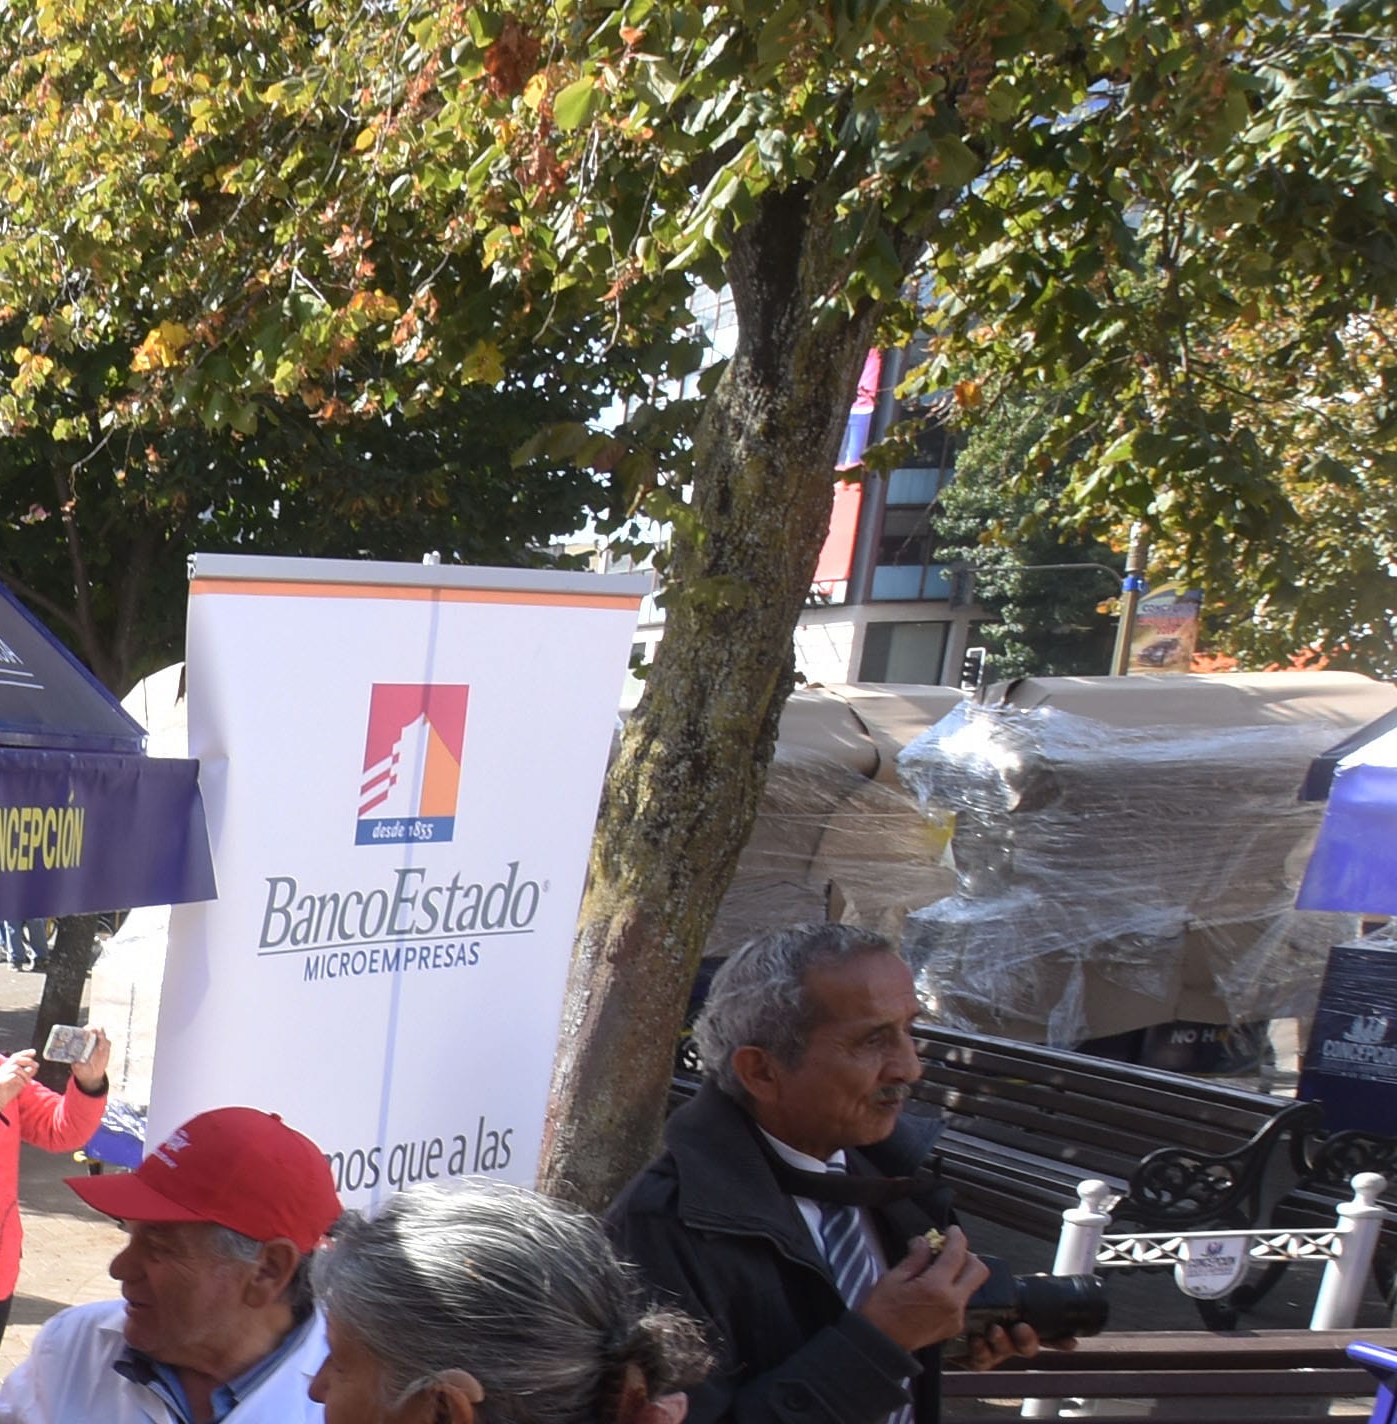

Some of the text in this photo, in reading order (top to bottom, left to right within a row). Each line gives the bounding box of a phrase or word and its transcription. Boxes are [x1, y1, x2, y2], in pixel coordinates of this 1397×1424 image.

[372, 821, 434, 840] desde 1855
[259, 861, 539, 948] BancoEstado
[304, 942, 480, 982] MICROEMPRESAS
[388, 1138, 443, 1192] que
[447, 1135, 466, 1175] a
[473, 1116, 513, 1172] las
